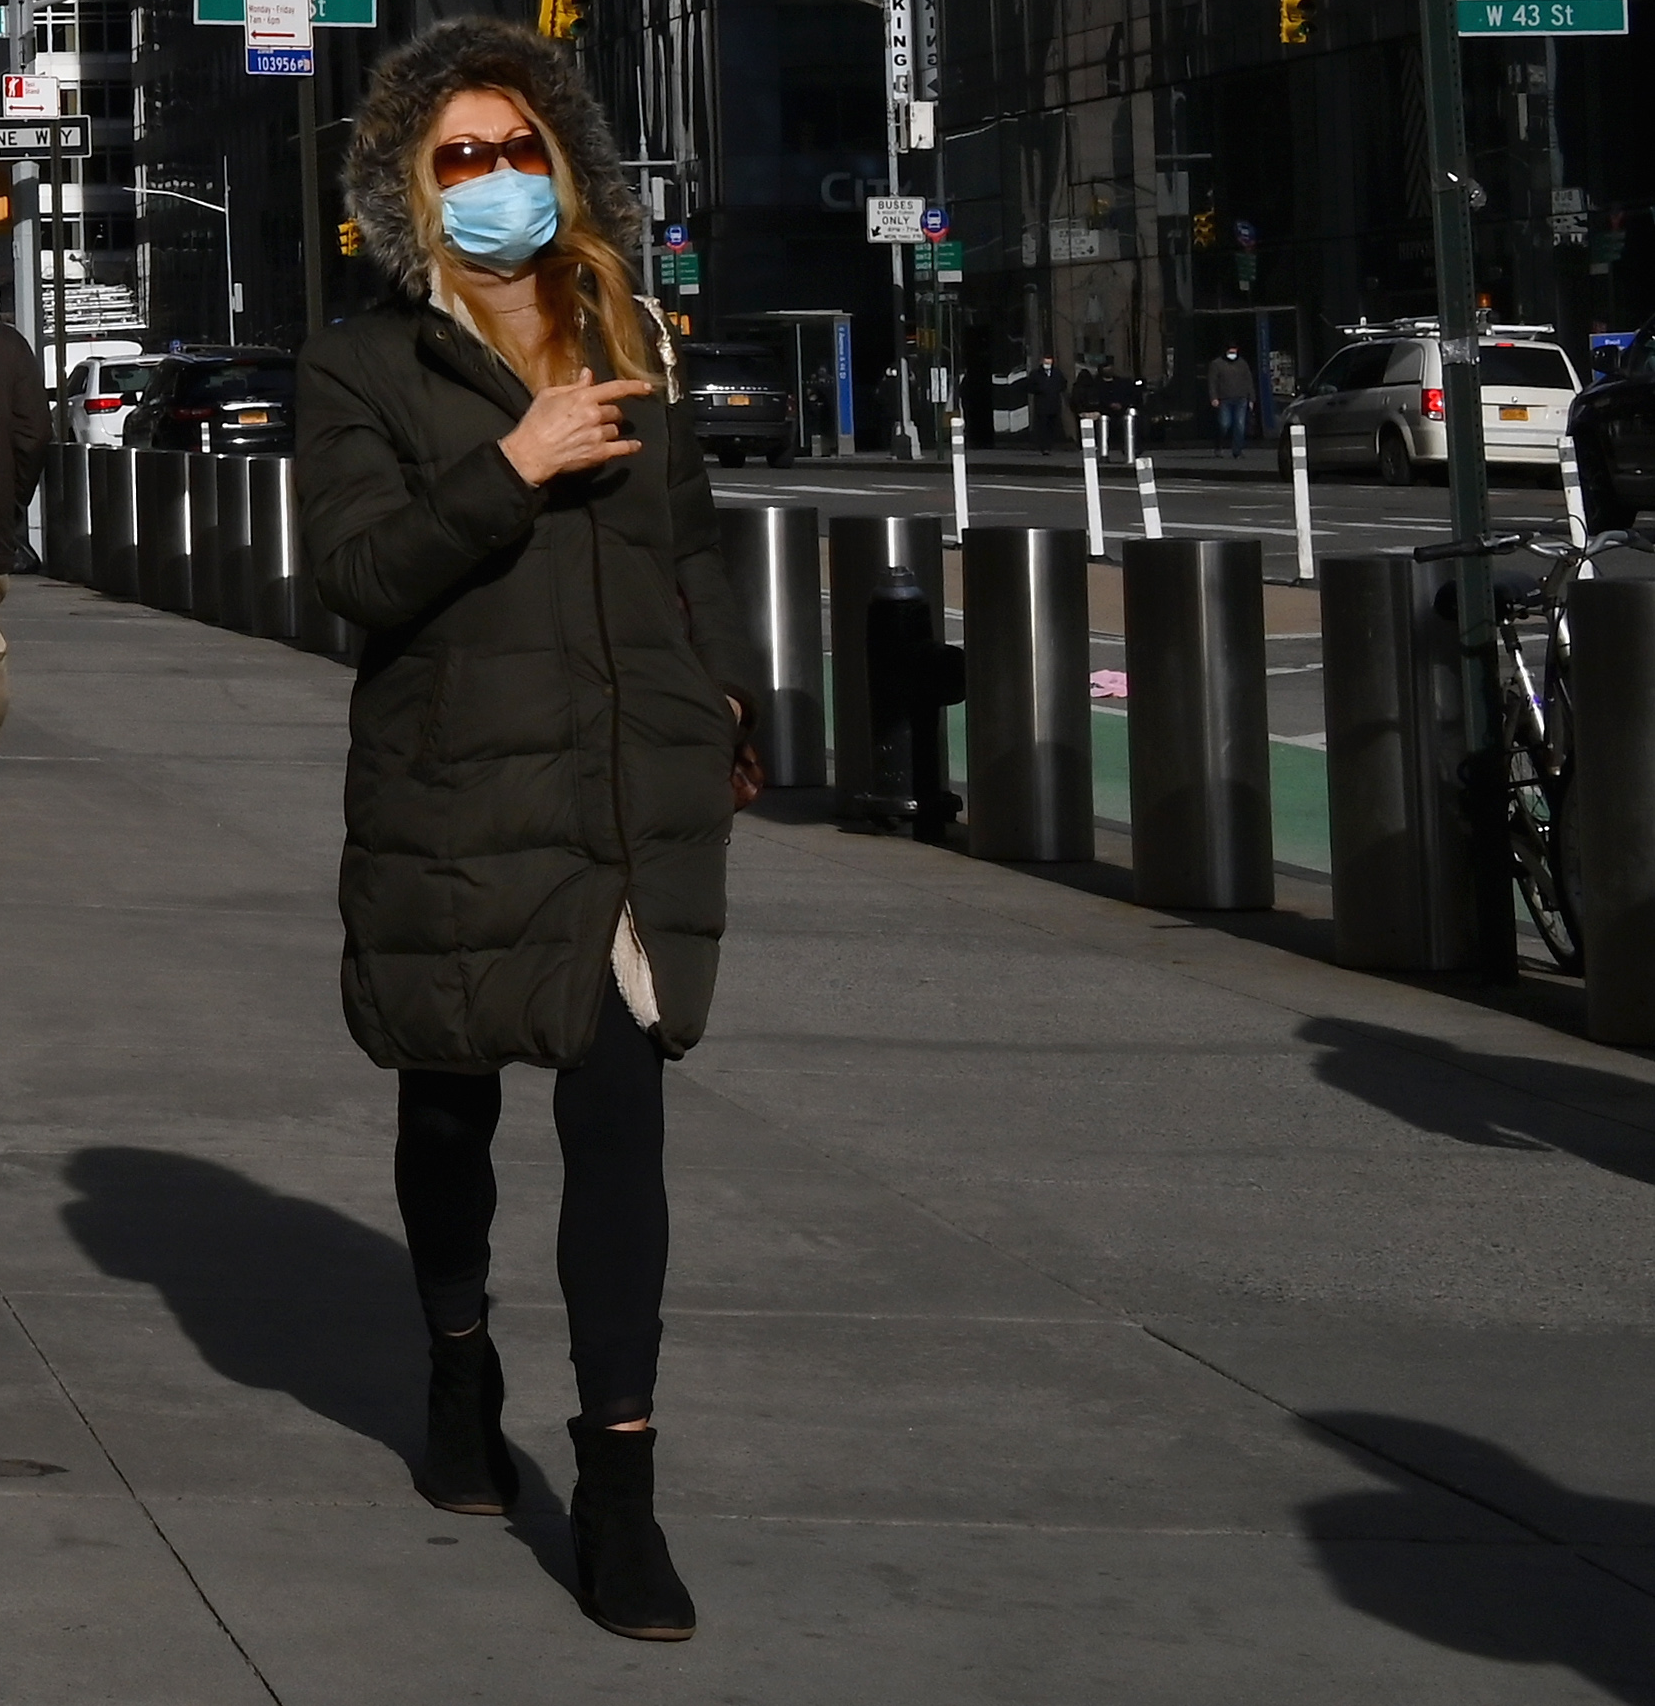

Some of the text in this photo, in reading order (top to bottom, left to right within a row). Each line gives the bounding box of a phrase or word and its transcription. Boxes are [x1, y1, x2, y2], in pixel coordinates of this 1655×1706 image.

[1486, 4, 1574, 27] W 43 St
[257, 57, 297, 71] 103956
[36, 129, 72, 144] WY
[878, 200, 914, 210] BUSES
[882, 216, 910, 225] ONLY
